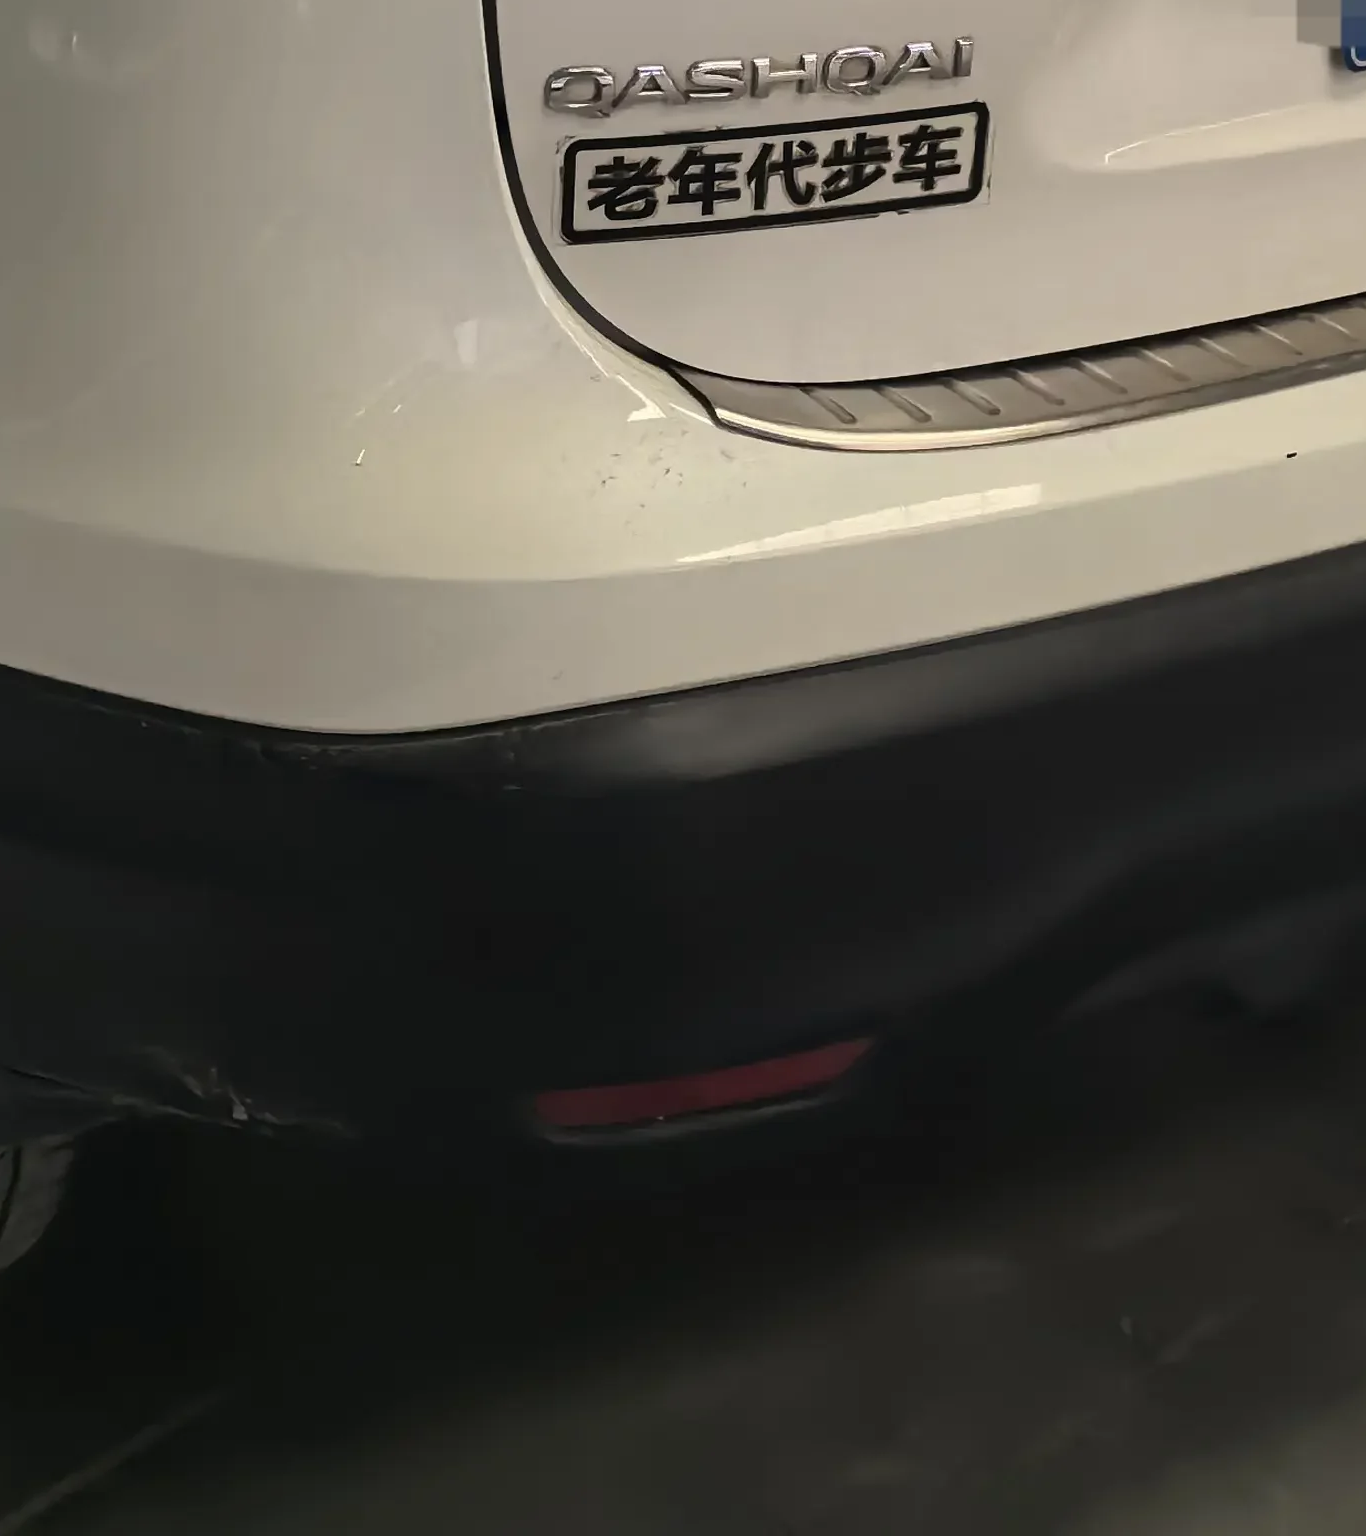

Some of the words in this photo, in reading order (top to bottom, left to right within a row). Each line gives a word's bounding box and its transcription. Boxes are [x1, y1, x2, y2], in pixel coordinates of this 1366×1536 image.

[544, 36, 976, 118] QASHQAI
[586, 124, 964, 222] 老年代步车
